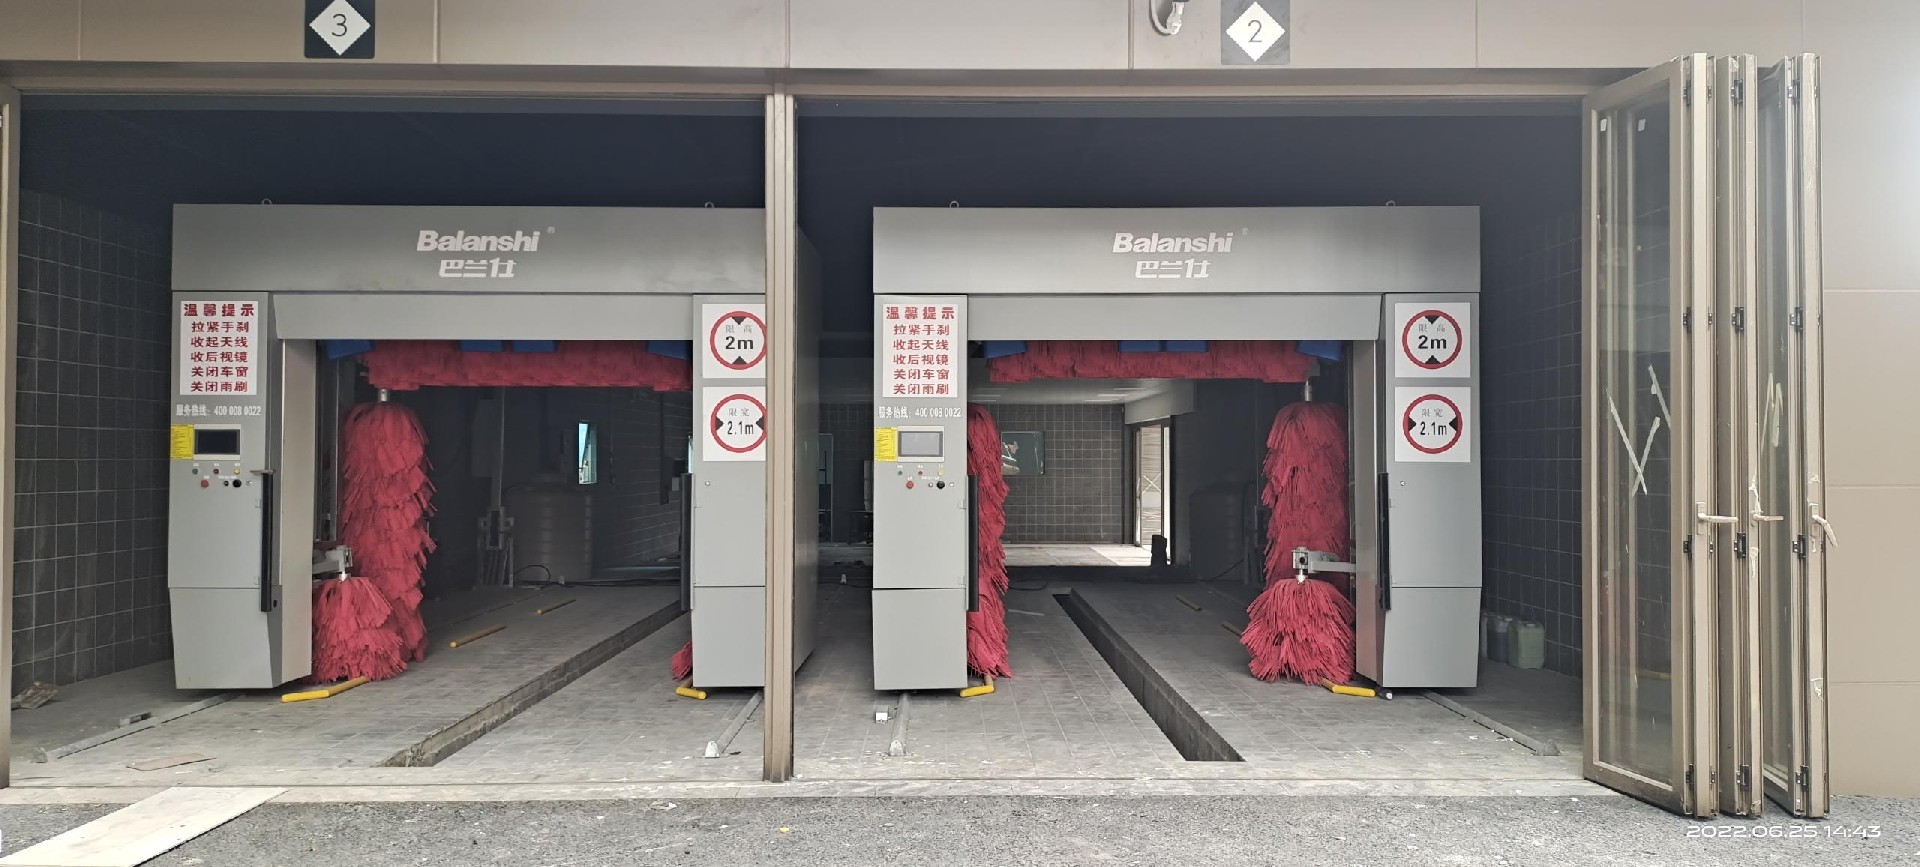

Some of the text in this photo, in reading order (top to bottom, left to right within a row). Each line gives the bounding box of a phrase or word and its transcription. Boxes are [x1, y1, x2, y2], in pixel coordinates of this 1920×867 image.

[331, 13, 348, 37] 3
[1247, 19, 1262, 43] 2
[416, 230, 541, 252] Balanshi
[1112, 232, 1234, 253] Balanshi
[438, 256, 517, 278] 巴兰仕
[1135, 258, 1211, 279] 巴兰仕
[183, 303, 255, 317] 温馨提示
[886, 306, 955, 320] 温馨提示
[191, 321, 249, 333] 拉紧手刹
[893, 324, 950, 336] 拉紧手刹
[190, 336, 249, 348] 收起天线
[725, 335, 754, 350] 2m
[893, 339, 949, 351] 收起天线
[1417, 334, 1447, 350] 2m
[190, 351, 248, 363] 收后视镜
[893, 354, 949, 366] 收后视镜
[191, 366, 249, 378] 关闭车窗
[893, 368, 950, 380] 关闭车窗
[190, 381, 248, 393] 关闭雨刷
[893, 383, 949, 395] 关闭雨刷
[727, 420, 754, 435] 2.1m
[1420, 421, 1447, 436] 2.1m
